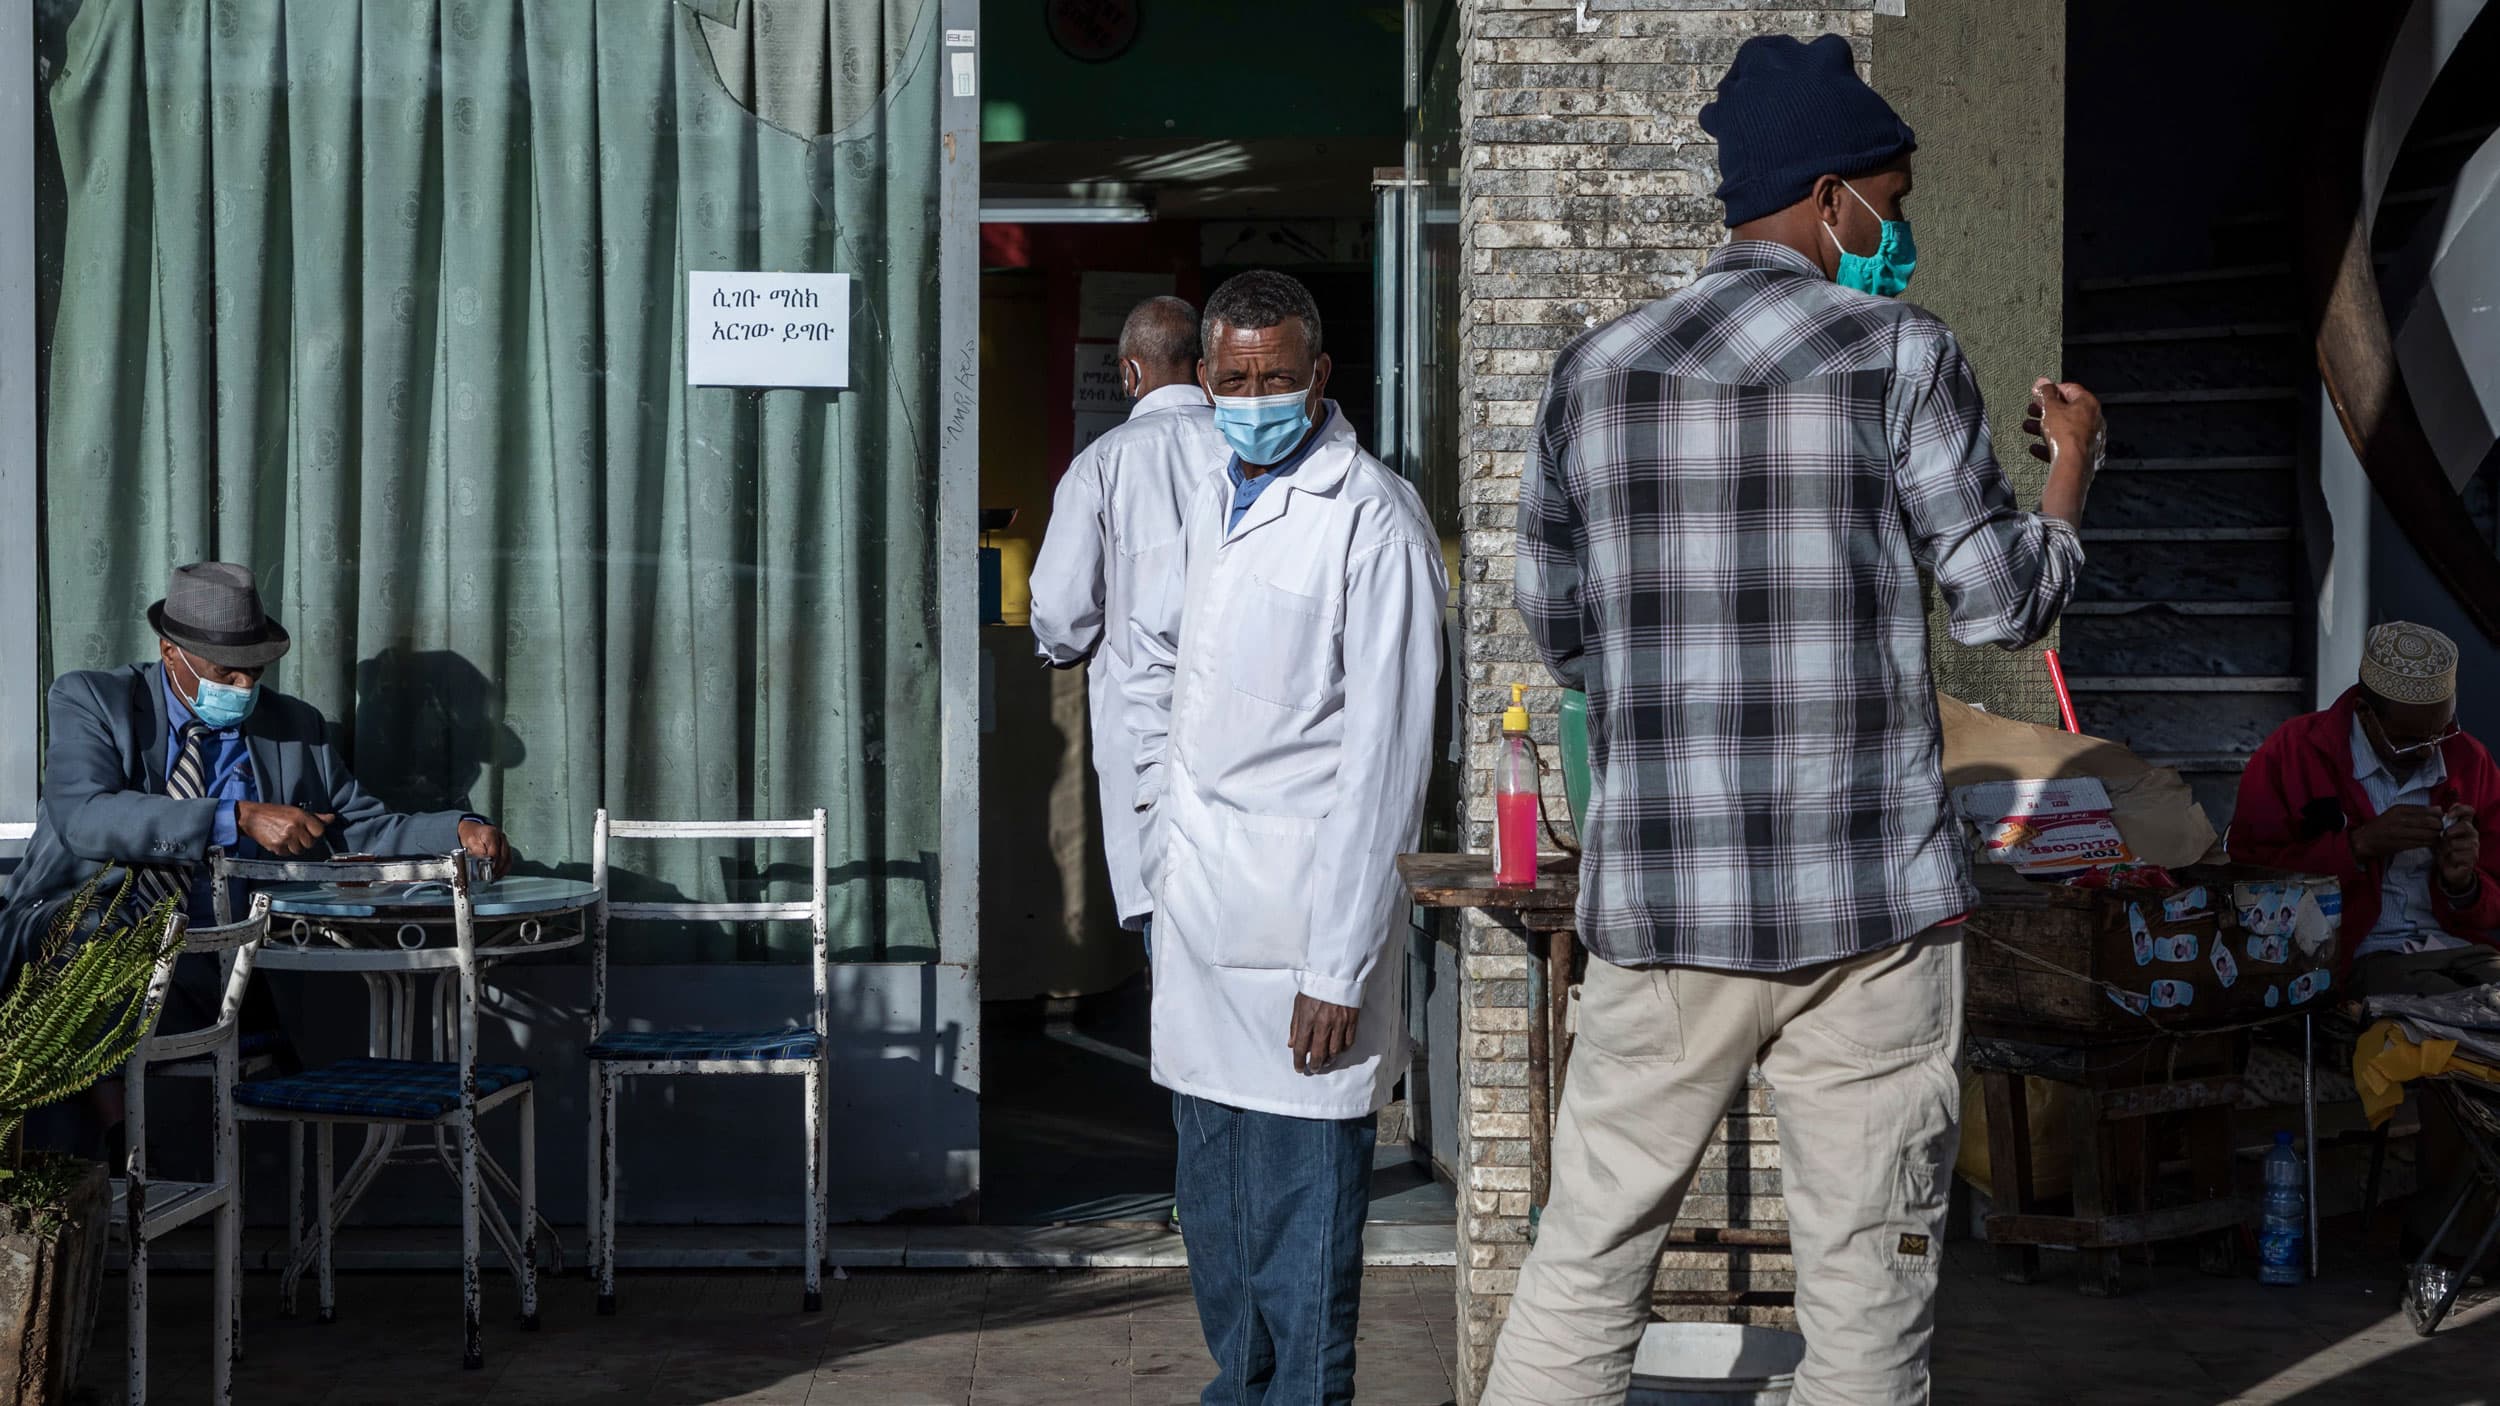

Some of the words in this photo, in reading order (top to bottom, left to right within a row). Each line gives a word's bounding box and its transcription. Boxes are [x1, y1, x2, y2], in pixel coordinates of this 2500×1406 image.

[713, 288, 760, 308] ሲገቡ
[769, 288, 818, 308] ማስክ
[712, 320, 774, 341] አርገው
[782, 322, 834, 343] ይግቡ
[2029, 838, 2119, 855] GLUCOSE
[2082, 849, 2121, 859] TOP
